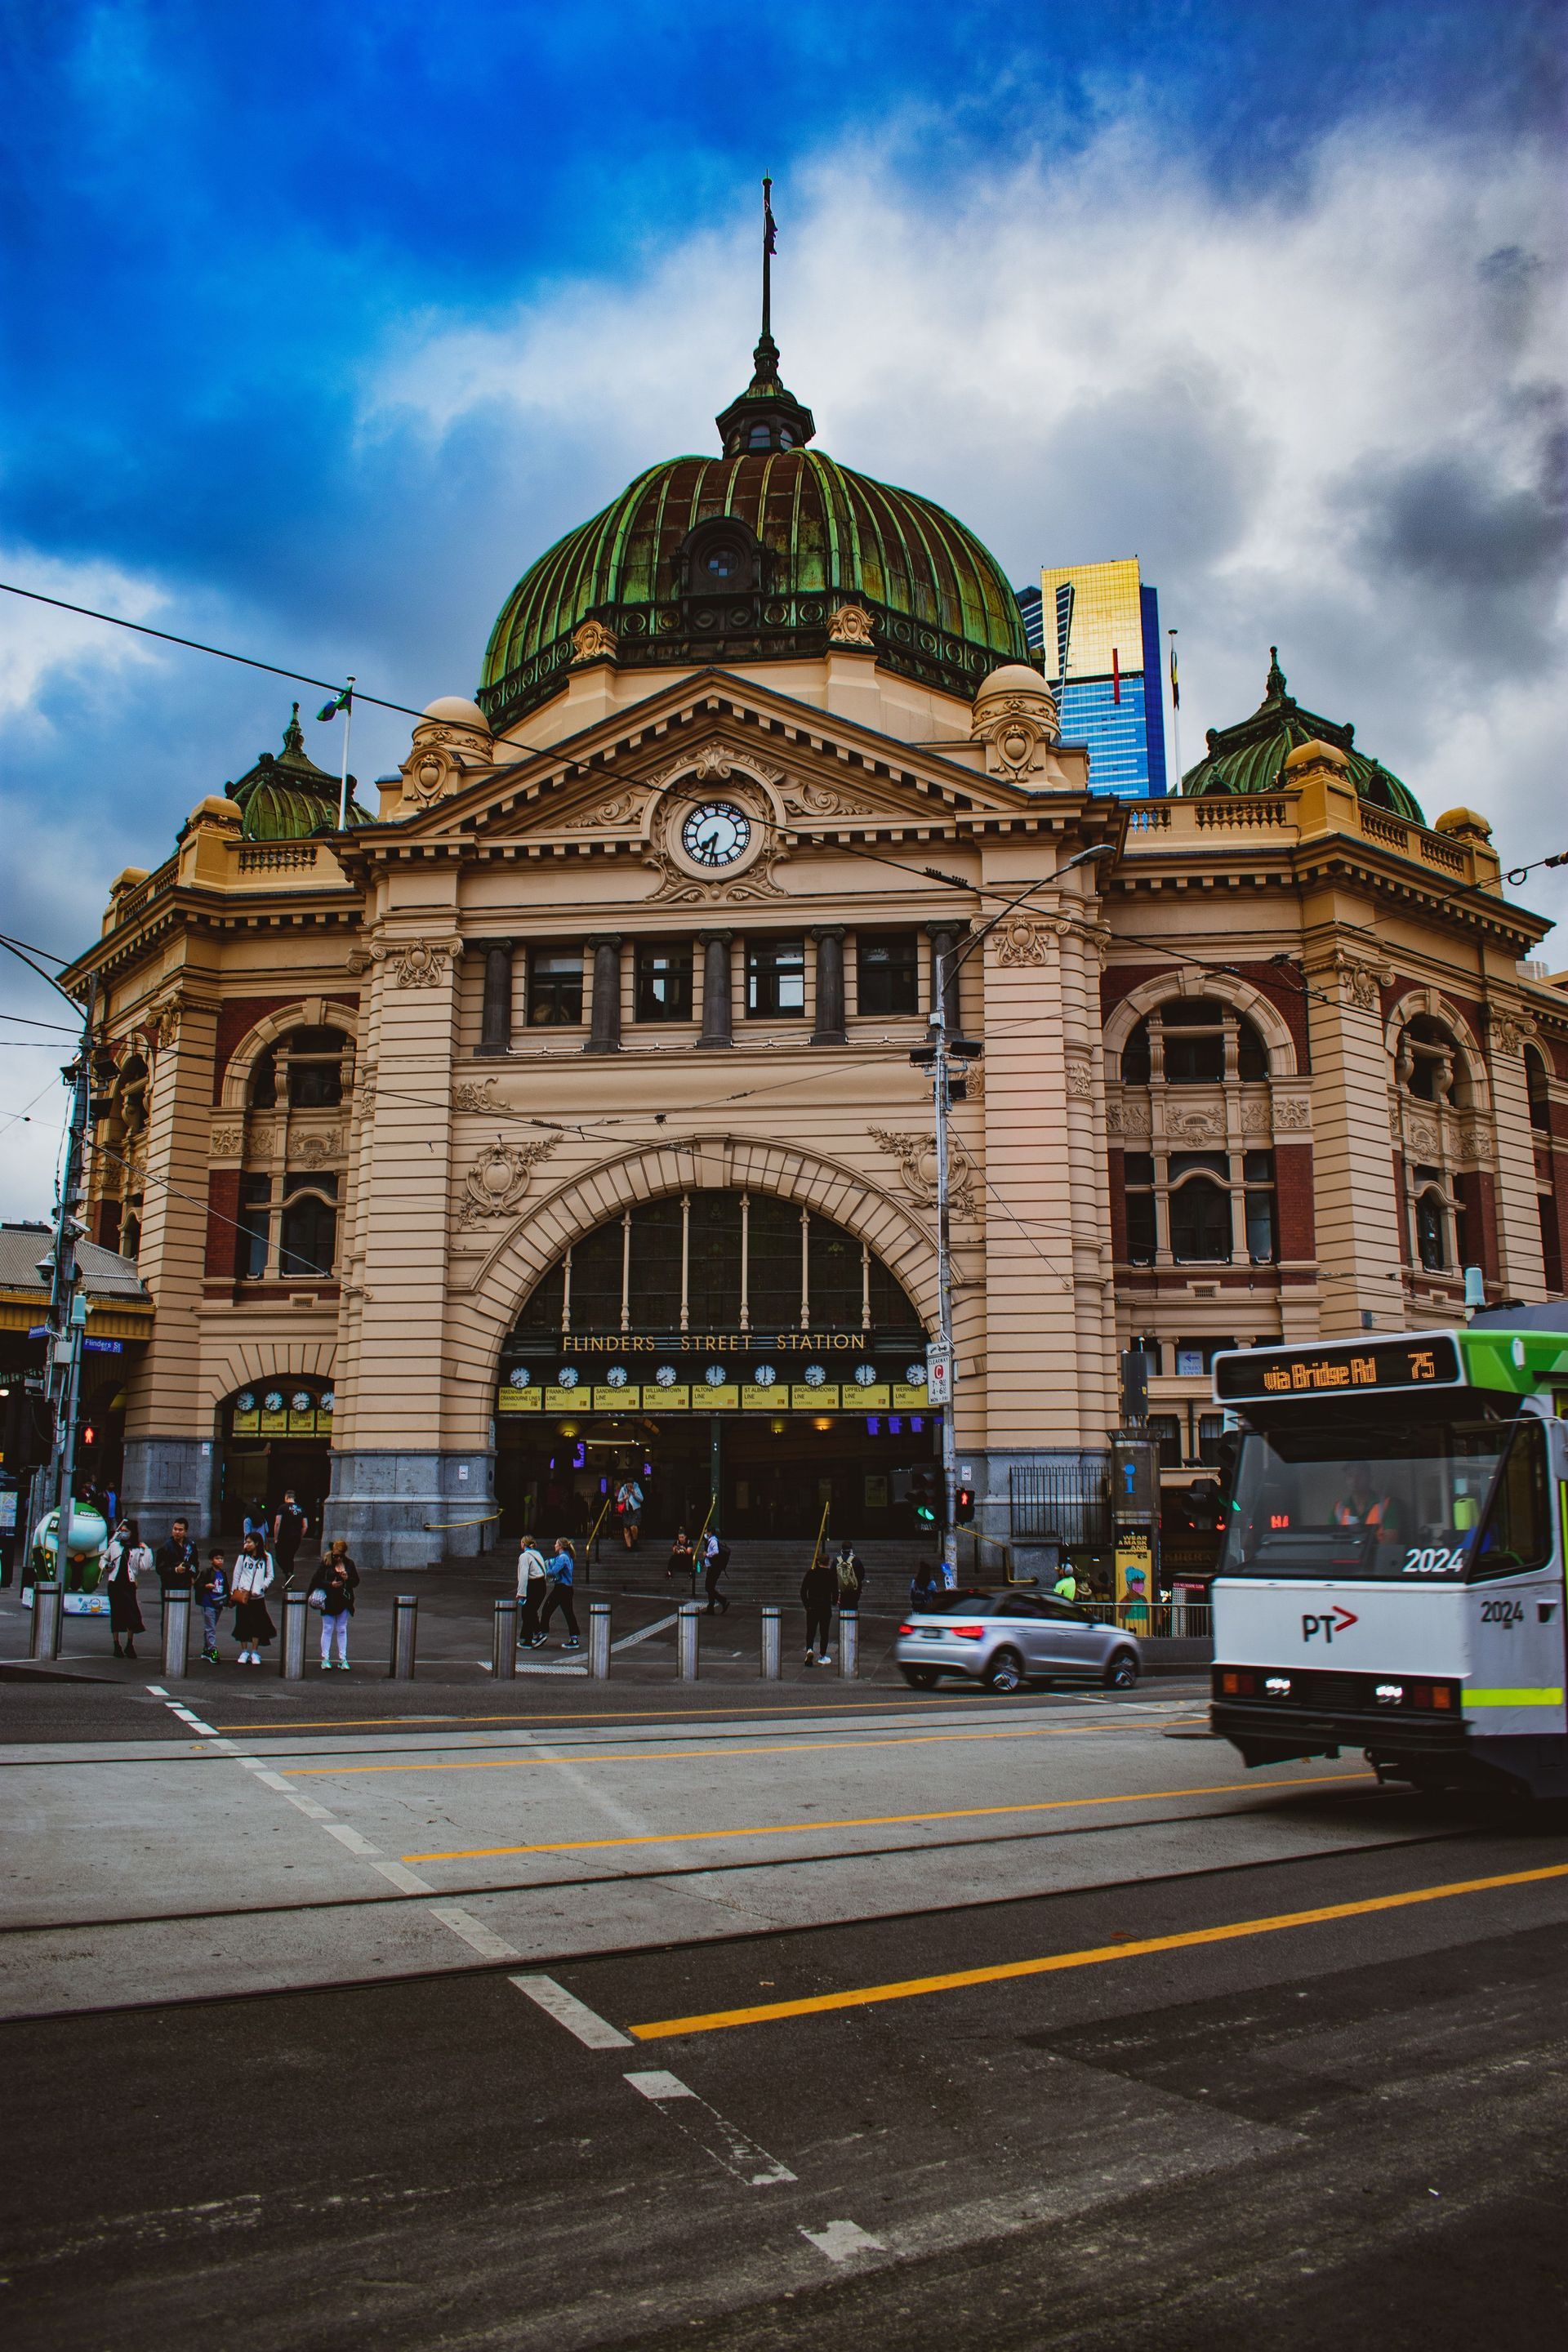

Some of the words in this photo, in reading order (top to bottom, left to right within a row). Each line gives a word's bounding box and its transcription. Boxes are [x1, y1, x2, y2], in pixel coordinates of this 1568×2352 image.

[85, 1339, 112, 1348] Flinders
[564, 1336, 655, 1352] FLINDERS
[681, 1334, 752, 1351] STREET
[777, 1334, 865, 1350] STATION
[928, 1356, 949, 1366] CLEARWAY
[1263, 1365, 1291, 1391] via
[1291, 1361, 1350, 1388] Bridge
[1350, 1357, 1377, 1384] Rd
[1408, 1352, 1435, 1379] 75
[1402, 1548, 1463, 1574] 2024
[1480, 1601, 1524, 1623] 2024
